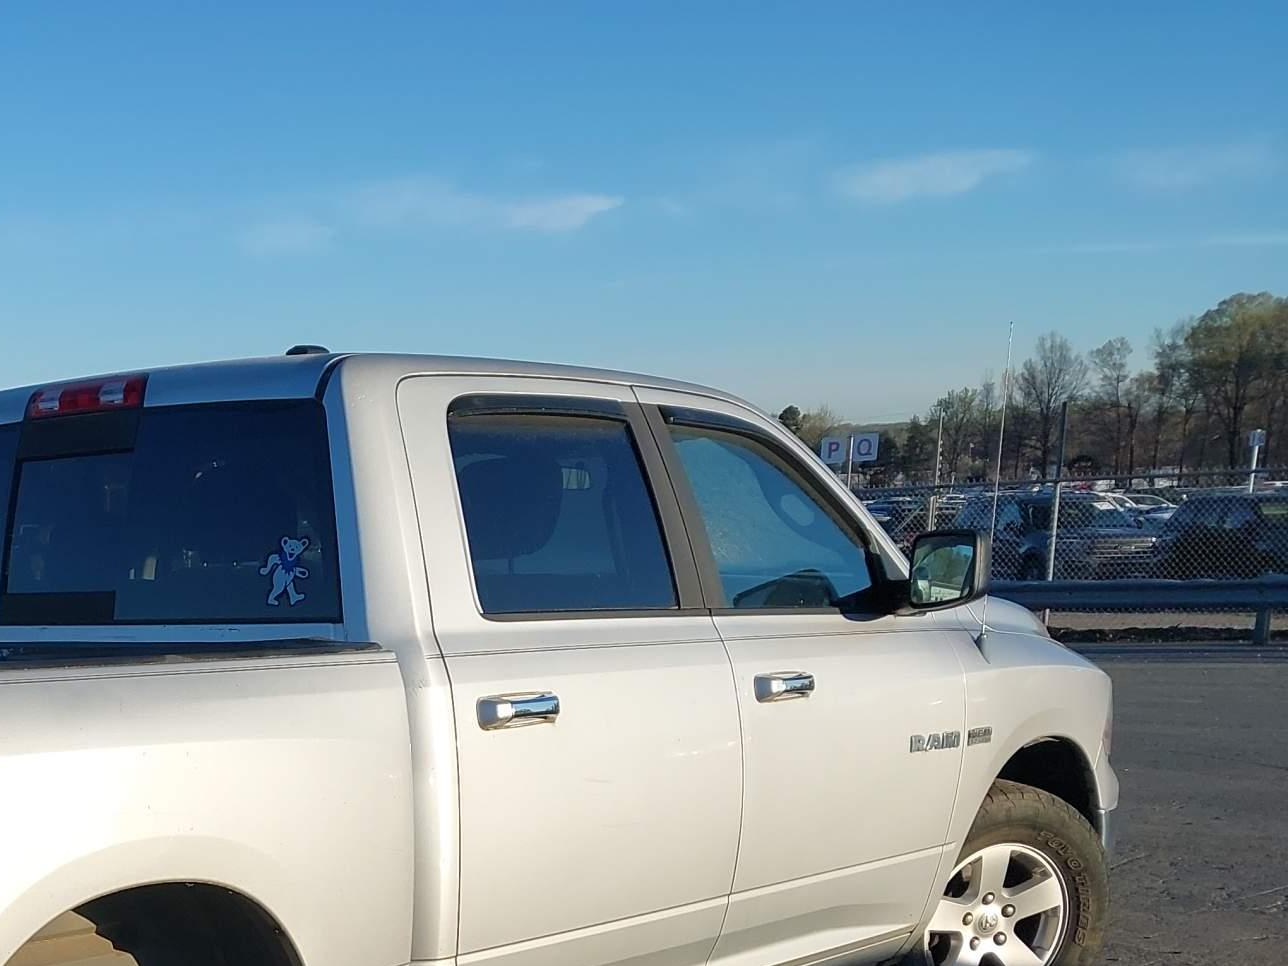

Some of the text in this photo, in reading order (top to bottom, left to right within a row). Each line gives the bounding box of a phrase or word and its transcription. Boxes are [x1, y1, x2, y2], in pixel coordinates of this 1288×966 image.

[827, 441, 841, 459] P
[856, 438, 873, 456] Q
[909, 730, 960, 753] RAM
[1037, 830, 1092, 947] TOYO TIRES
